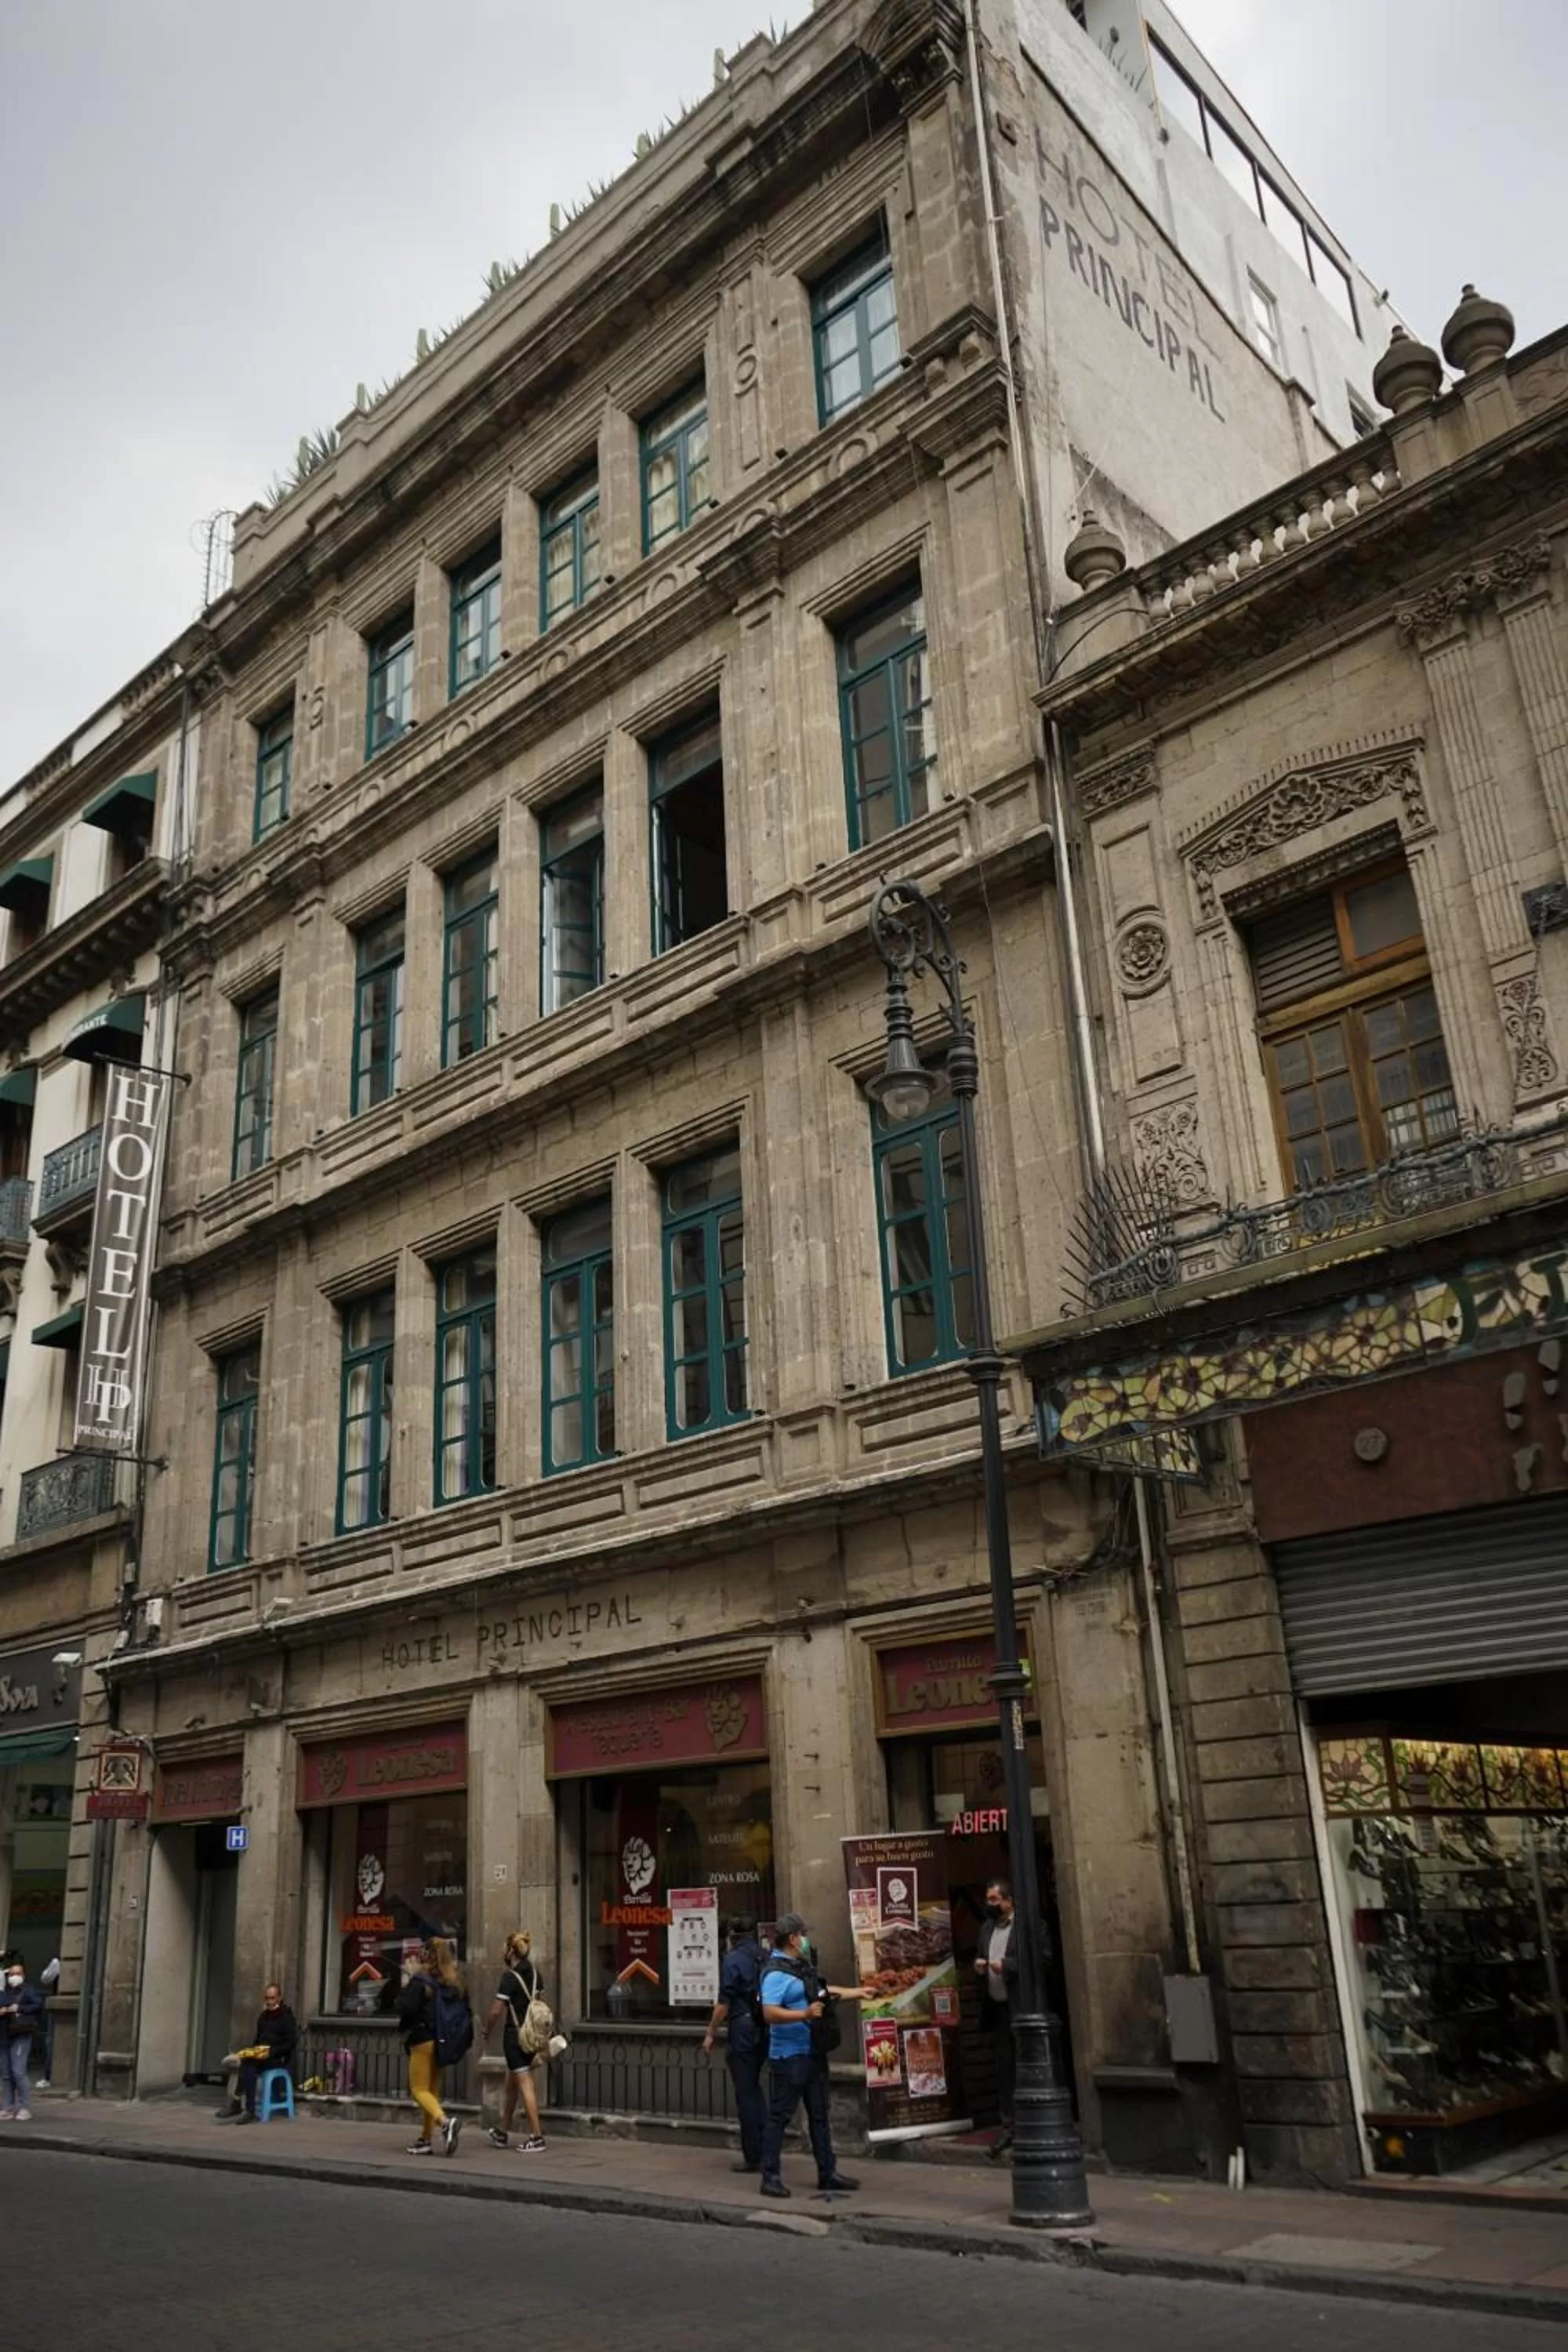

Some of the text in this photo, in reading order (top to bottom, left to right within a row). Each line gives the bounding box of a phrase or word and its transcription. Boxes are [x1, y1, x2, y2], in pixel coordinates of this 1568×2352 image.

[1035, 124, 1222, 363] HOTEL
[1039, 194, 1227, 424] PRINCIPAL
[92, 1073, 160, 1359] HOTEL
[382, 1593, 643, 1669] HOTEL PRINCIPAL
[886, 1674, 993, 1714] Leone
[231, 1829, 244, 1846] H
[952, 1808, 1008, 1835] ABIERT
[601, 1901, 673, 1925] Leonesa
